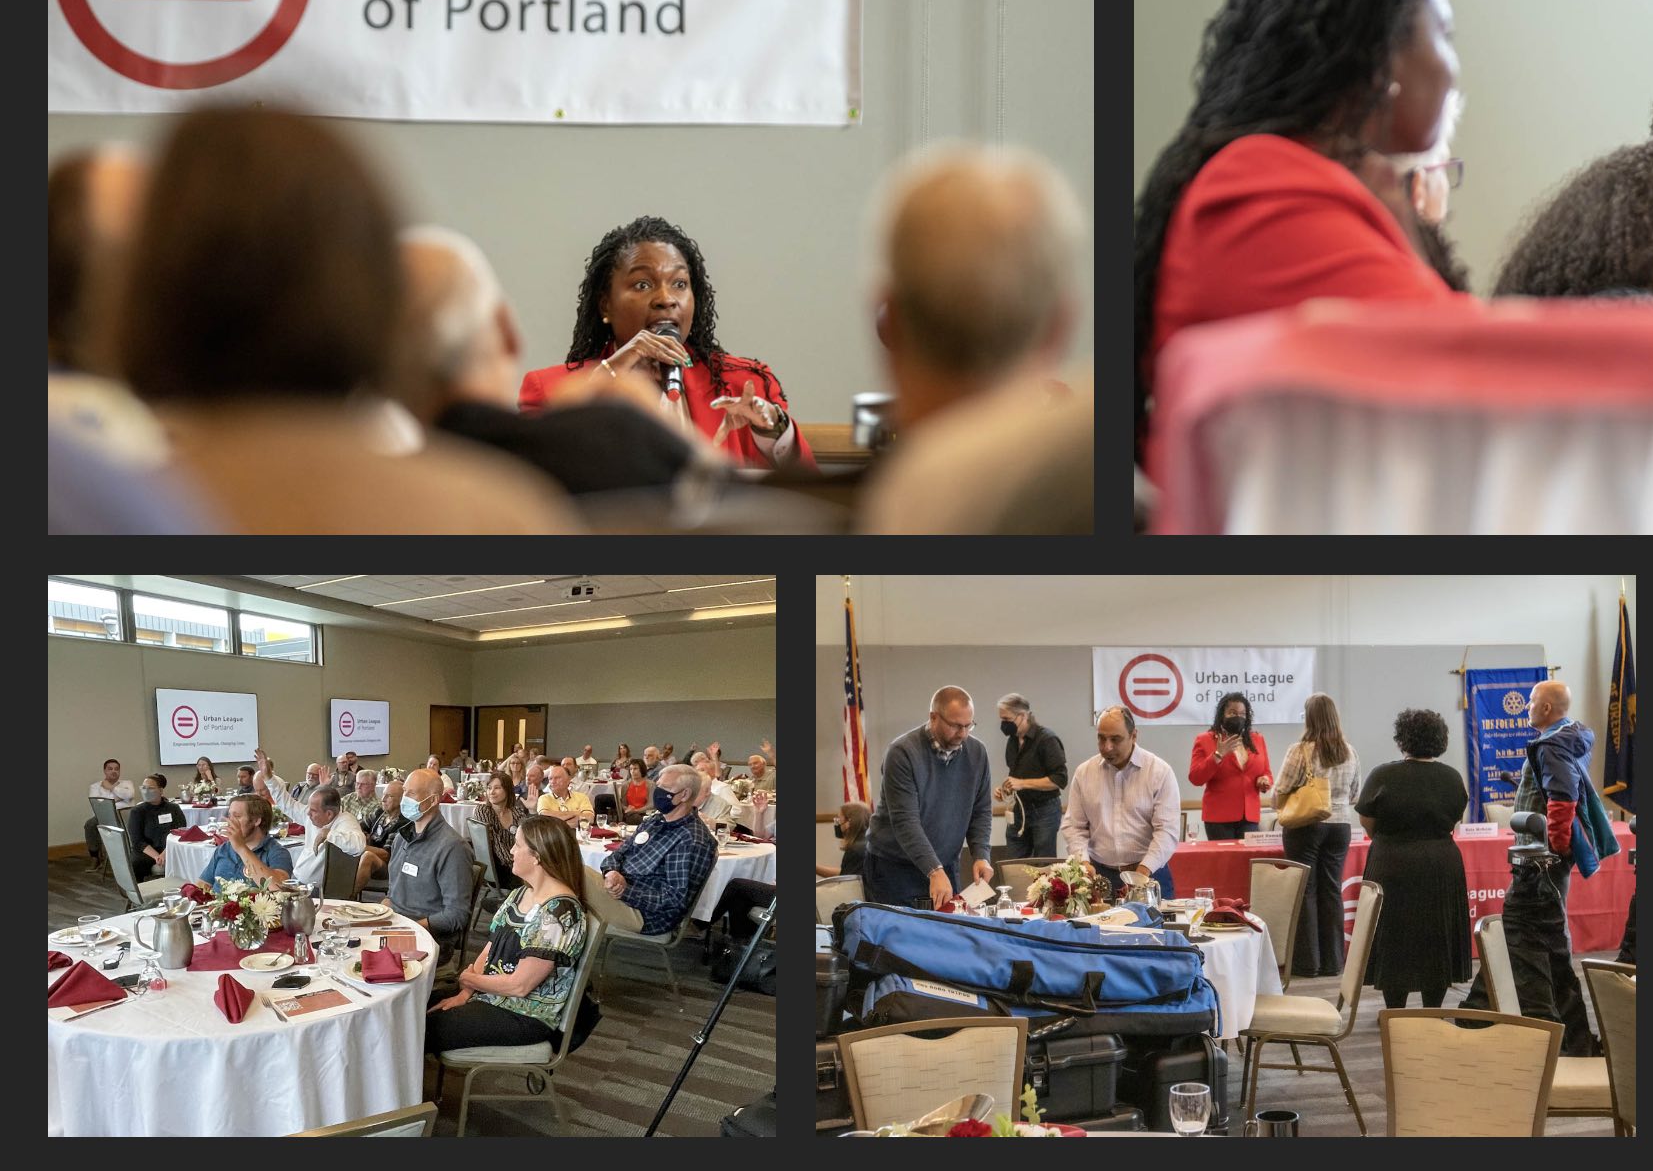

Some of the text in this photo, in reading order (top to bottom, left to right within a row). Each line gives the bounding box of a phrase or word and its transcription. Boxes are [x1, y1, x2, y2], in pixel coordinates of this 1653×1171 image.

[1195, 671, 1294, 686] Urban League
[1195, 690, 1275, 702] of Pland
[1467, 889, 1505, 902] ague
